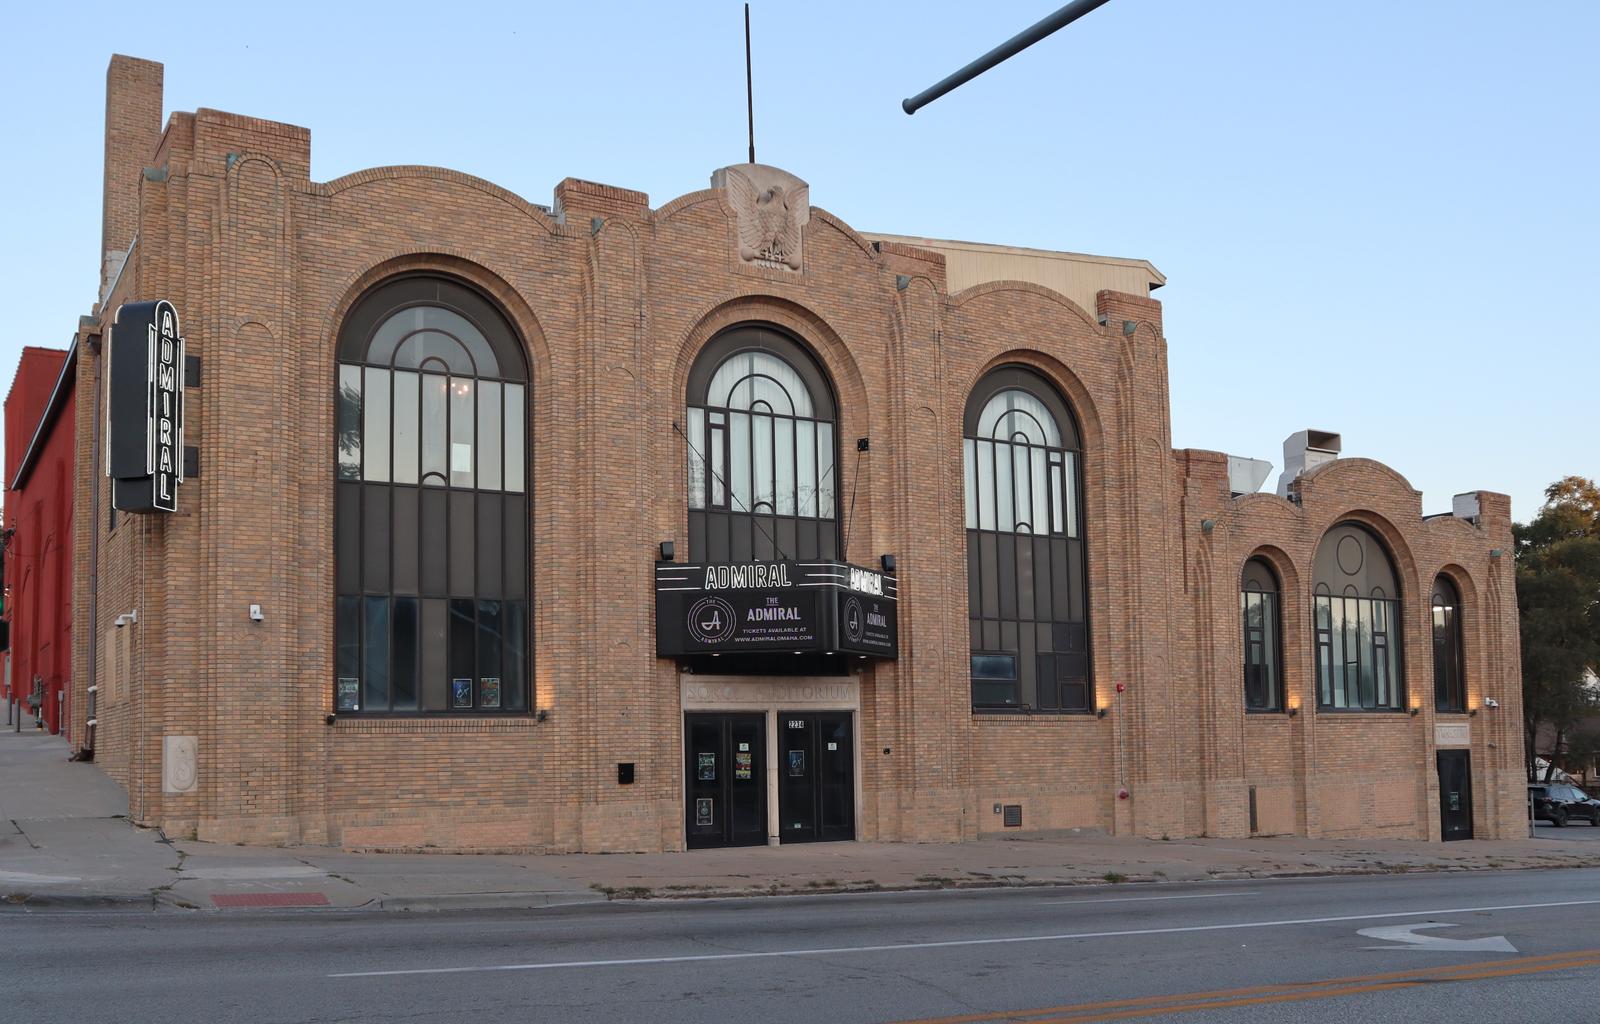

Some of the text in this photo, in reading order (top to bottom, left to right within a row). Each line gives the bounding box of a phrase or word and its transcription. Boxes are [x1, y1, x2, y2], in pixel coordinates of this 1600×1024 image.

[159, 311, 174, 500] ADMIRAL
[705, 564, 792, 589] ADMIRAL
[850, 567, 884, 596] ADMIRAL
[747, 607, 801, 621] ADMIRAL
